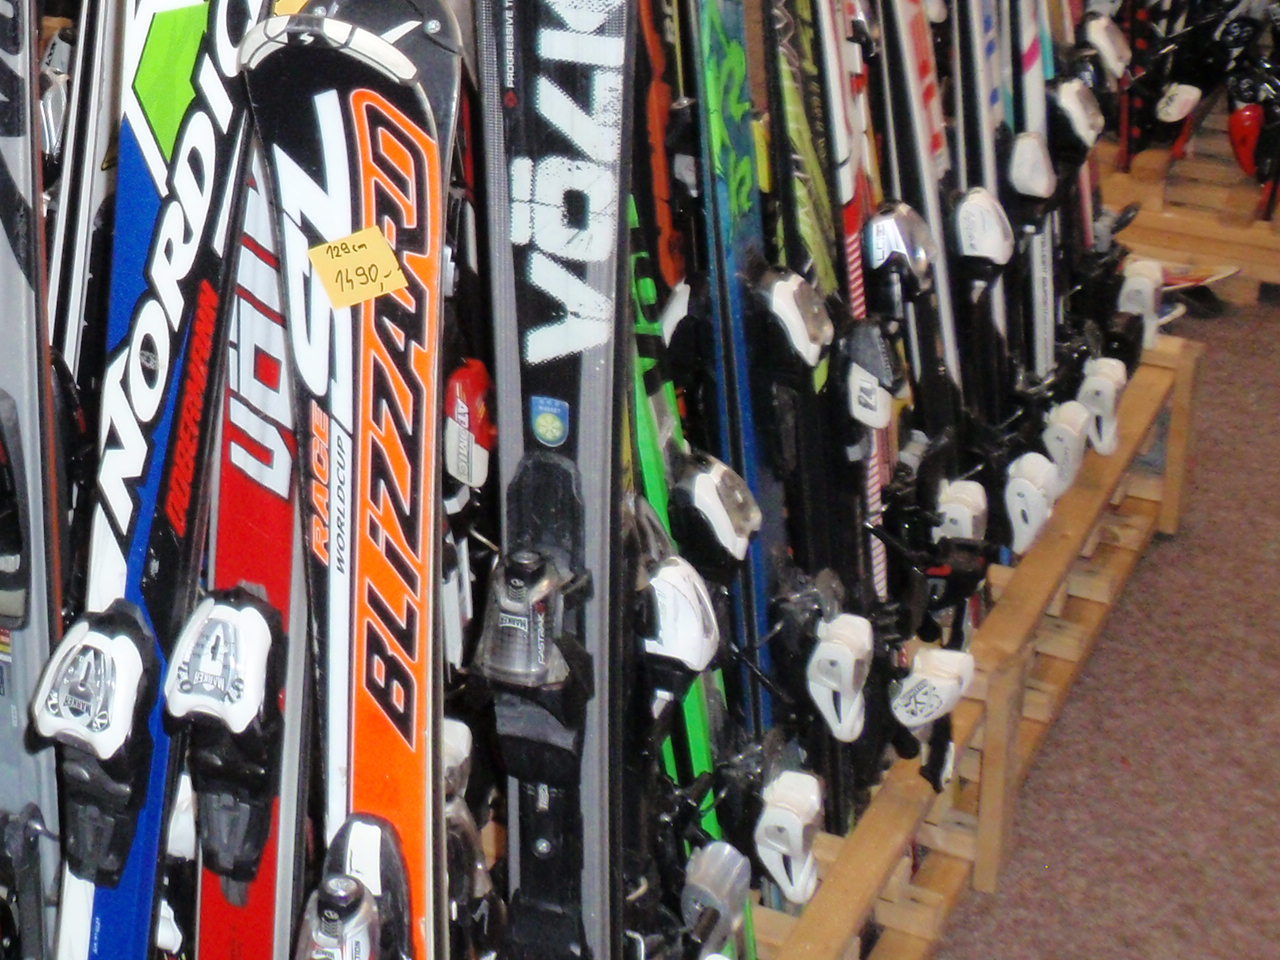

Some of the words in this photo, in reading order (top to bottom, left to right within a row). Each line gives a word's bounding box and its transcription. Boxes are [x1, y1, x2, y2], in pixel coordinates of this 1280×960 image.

[505, 5, 515, 88] PROGRESSIVE
[165, 279, 219, 538] DOBERMANN
[310, 401, 331, 566] RACE
[364, 89, 436, 751] BLIZZARD
[335, 433, 354, 576] WORLDCUP
[63, 694, 93, 715] MARKER
